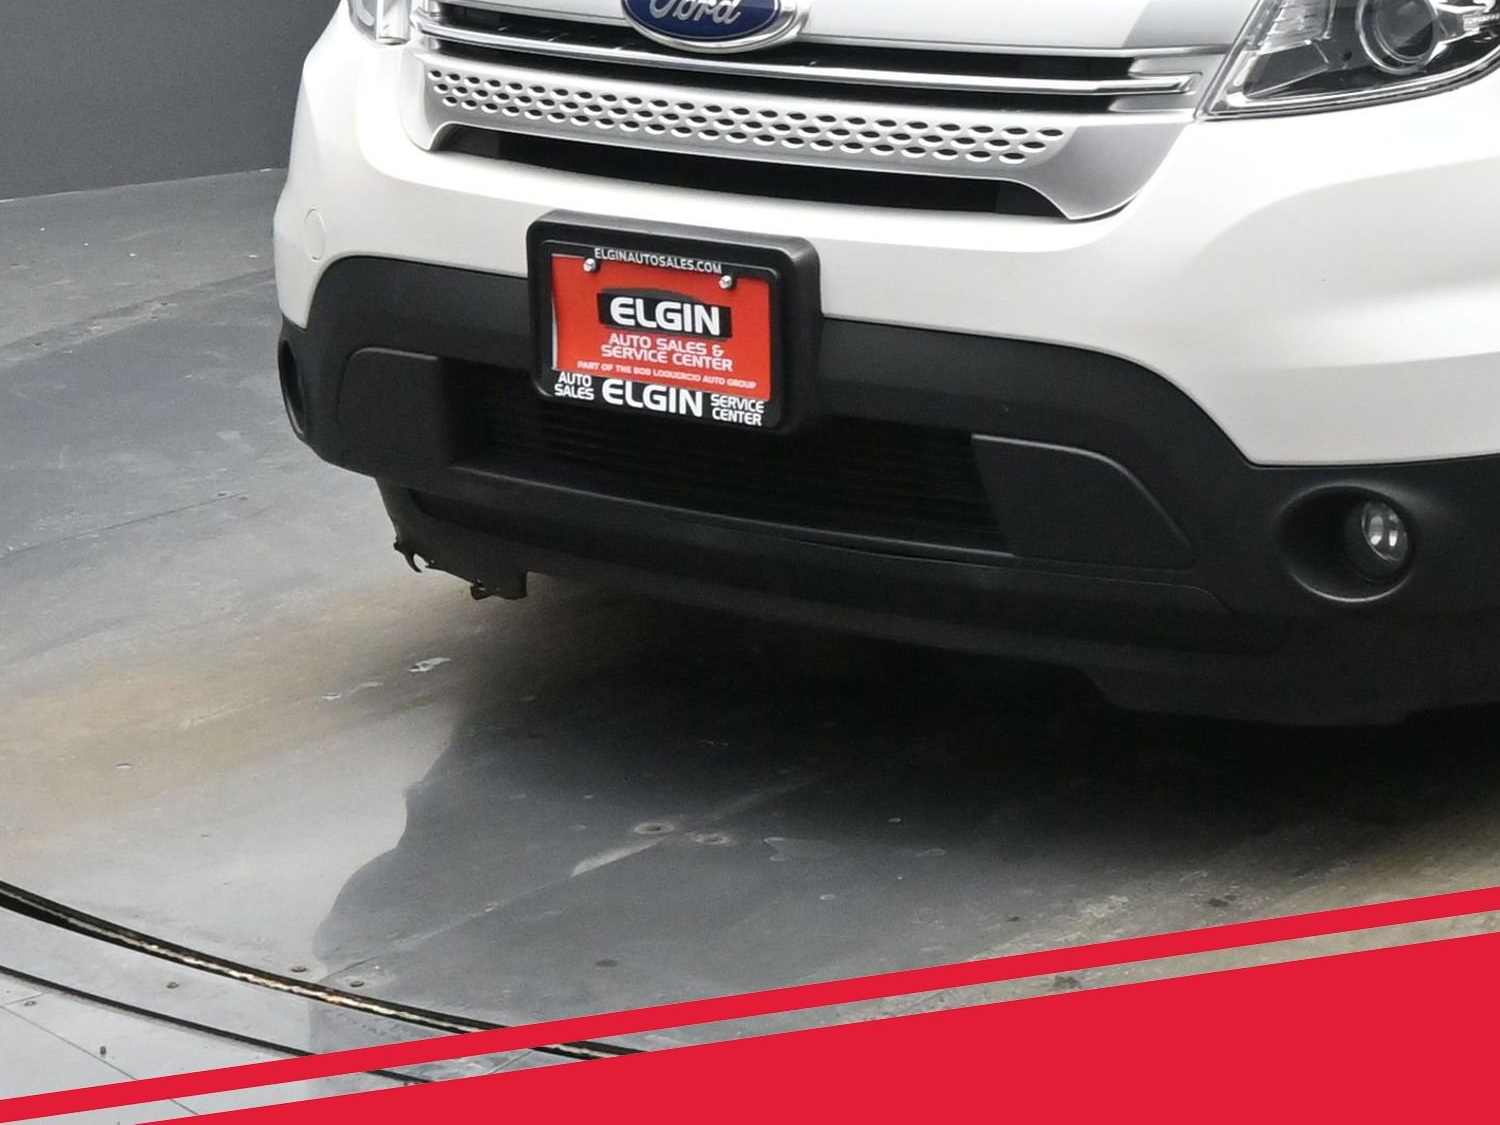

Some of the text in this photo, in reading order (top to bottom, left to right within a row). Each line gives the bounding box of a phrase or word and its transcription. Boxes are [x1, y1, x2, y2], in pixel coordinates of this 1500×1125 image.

[594, 247, 722, 274] ELGINAUTOSALES.COM
[610, 296, 720, 336] ELGIN
[609, 333, 724, 357] AUTO SALES &
[601, 345, 733, 372] SERVICE CENTER
[558, 371, 592, 386] AUTO
[577, 360, 599, 371] PART
[601, 363, 613, 372] OF
[615, 364, 632, 374] THE
[633, 367, 651, 376] BOB
[702, 376, 725, 386] AUTO
[727, 378, 757, 389] GROUP
[554, 383, 594, 402] SALES
[602, 378, 703, 417] ELGIN
[710, 393, 764, 414] SERVICE
[712, 408, 763, 426] CENTER
